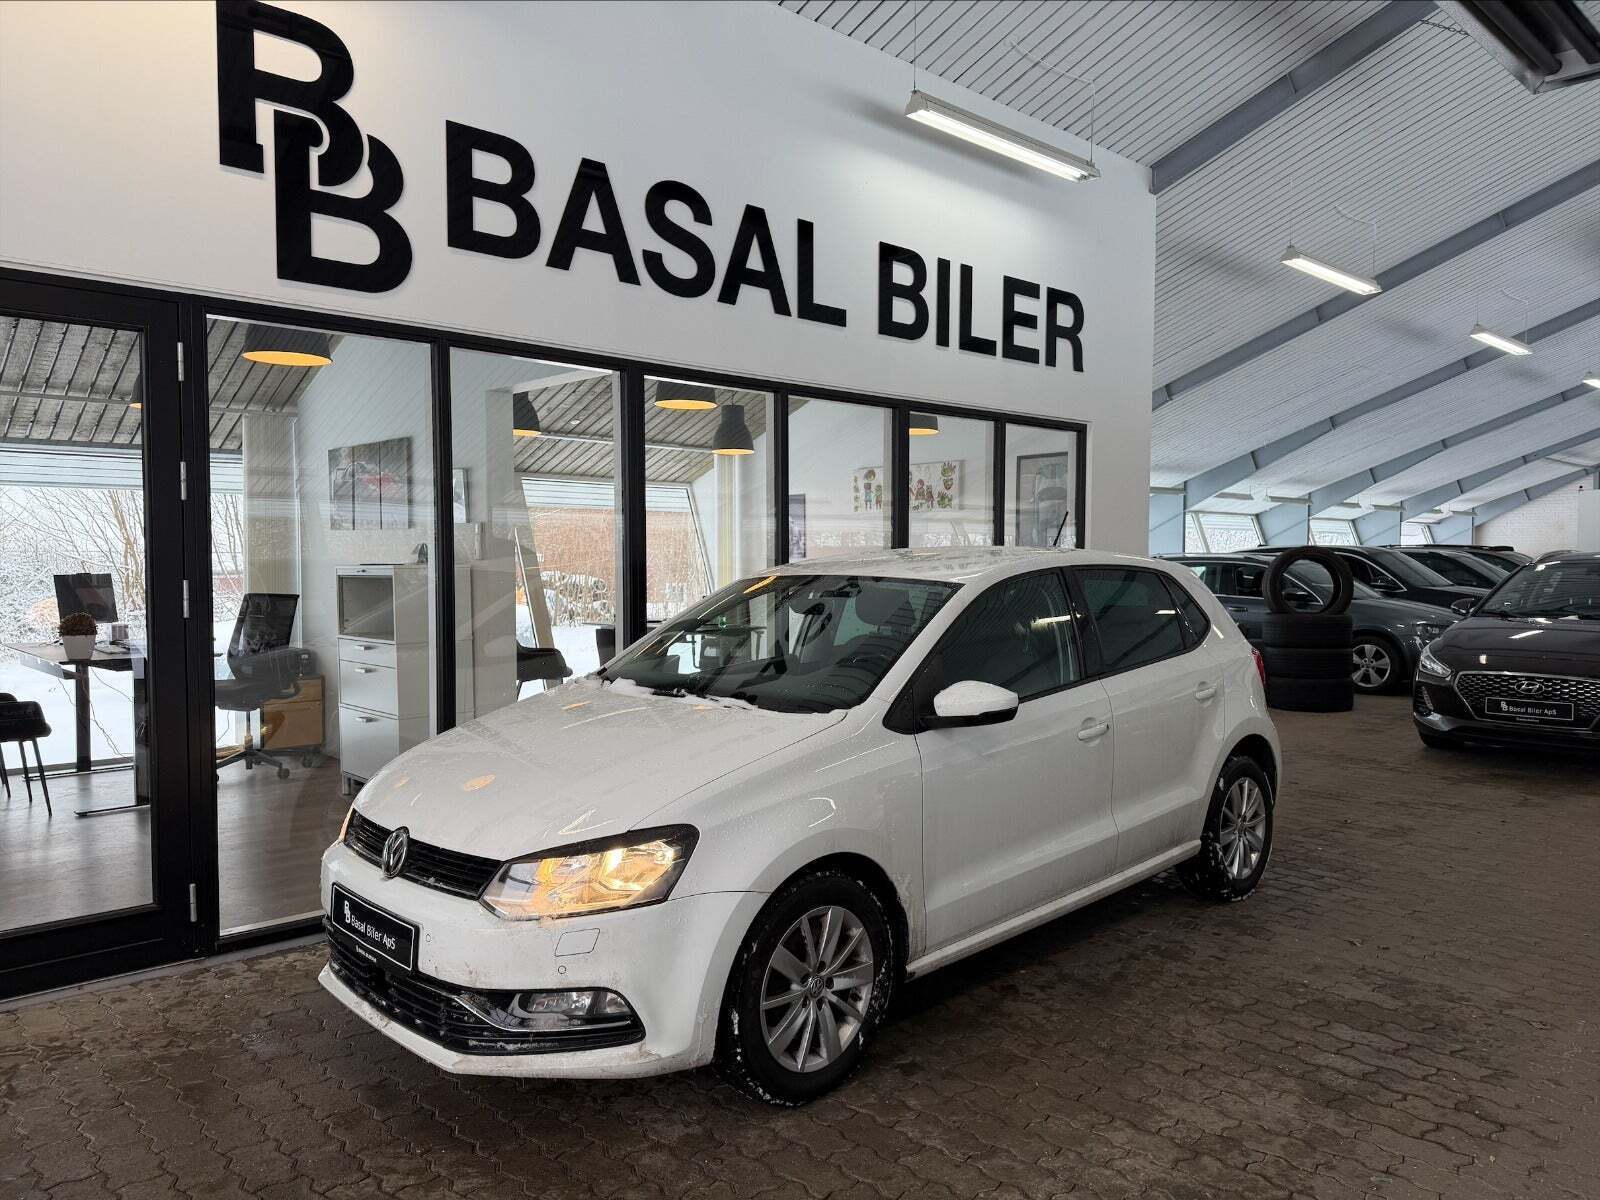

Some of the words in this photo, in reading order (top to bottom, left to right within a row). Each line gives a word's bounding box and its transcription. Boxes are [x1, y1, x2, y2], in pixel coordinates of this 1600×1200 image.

[446, 120, 847, 328] BASAL
[878, 241, 1085, 373] BILER
[1509, 705, 1526, 713] Basal
[1527, 706, 1542, 714] Biler
[351, 914, 366, 933] Basal
[366, 924, 382, 942] Biler
[382, 933, 396, 950] ApS
